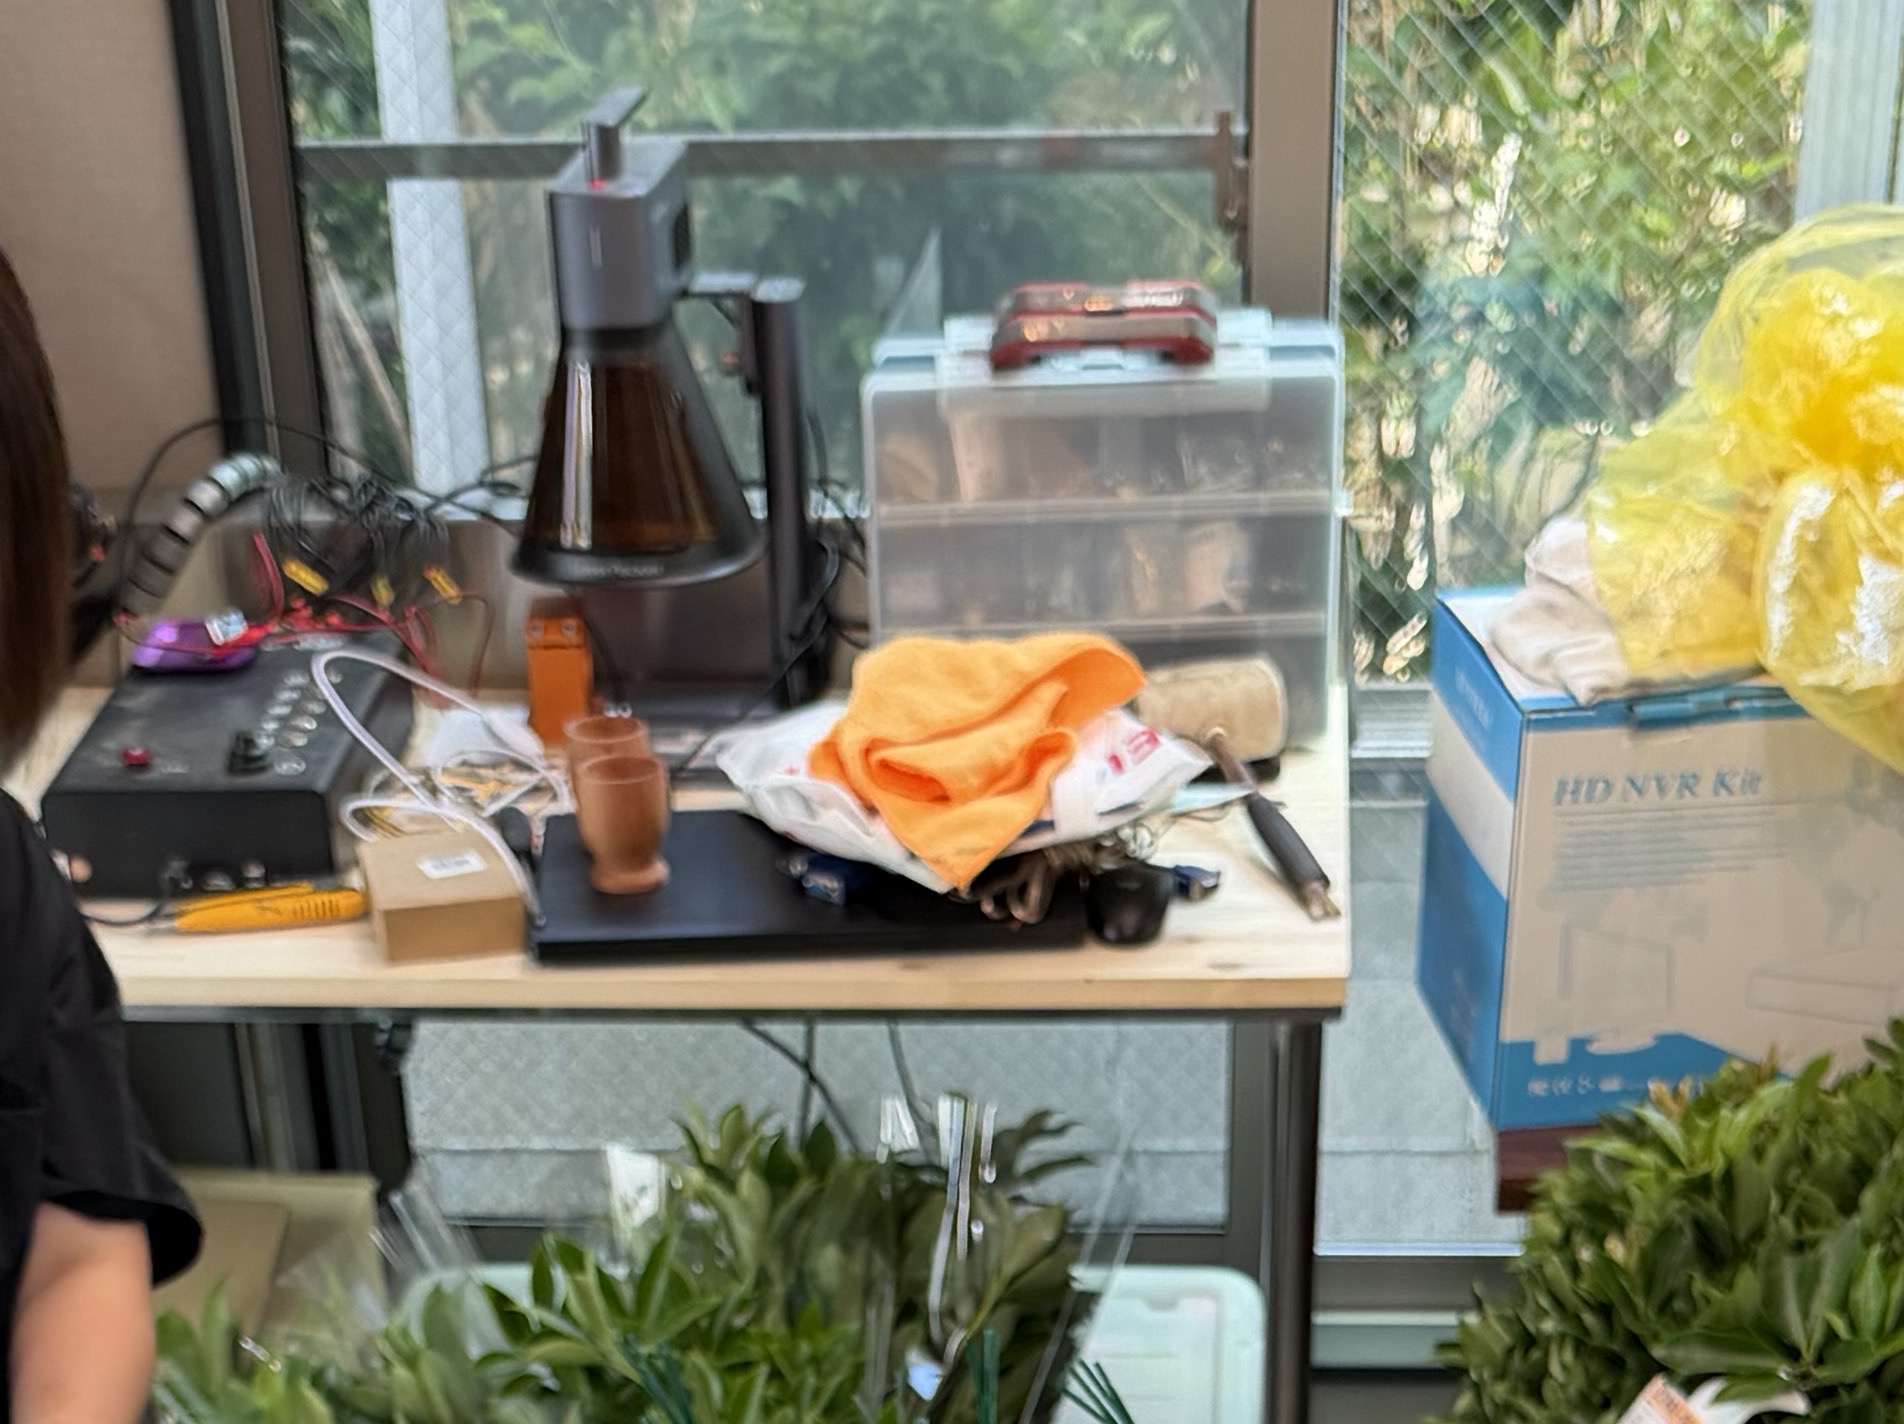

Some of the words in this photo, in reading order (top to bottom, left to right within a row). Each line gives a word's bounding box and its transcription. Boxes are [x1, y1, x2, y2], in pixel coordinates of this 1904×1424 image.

[1553, 776, 1614, 806] HD
[1620, 770, 1702, 802] NVR
[1710, 767, 1763, 798] Kit
